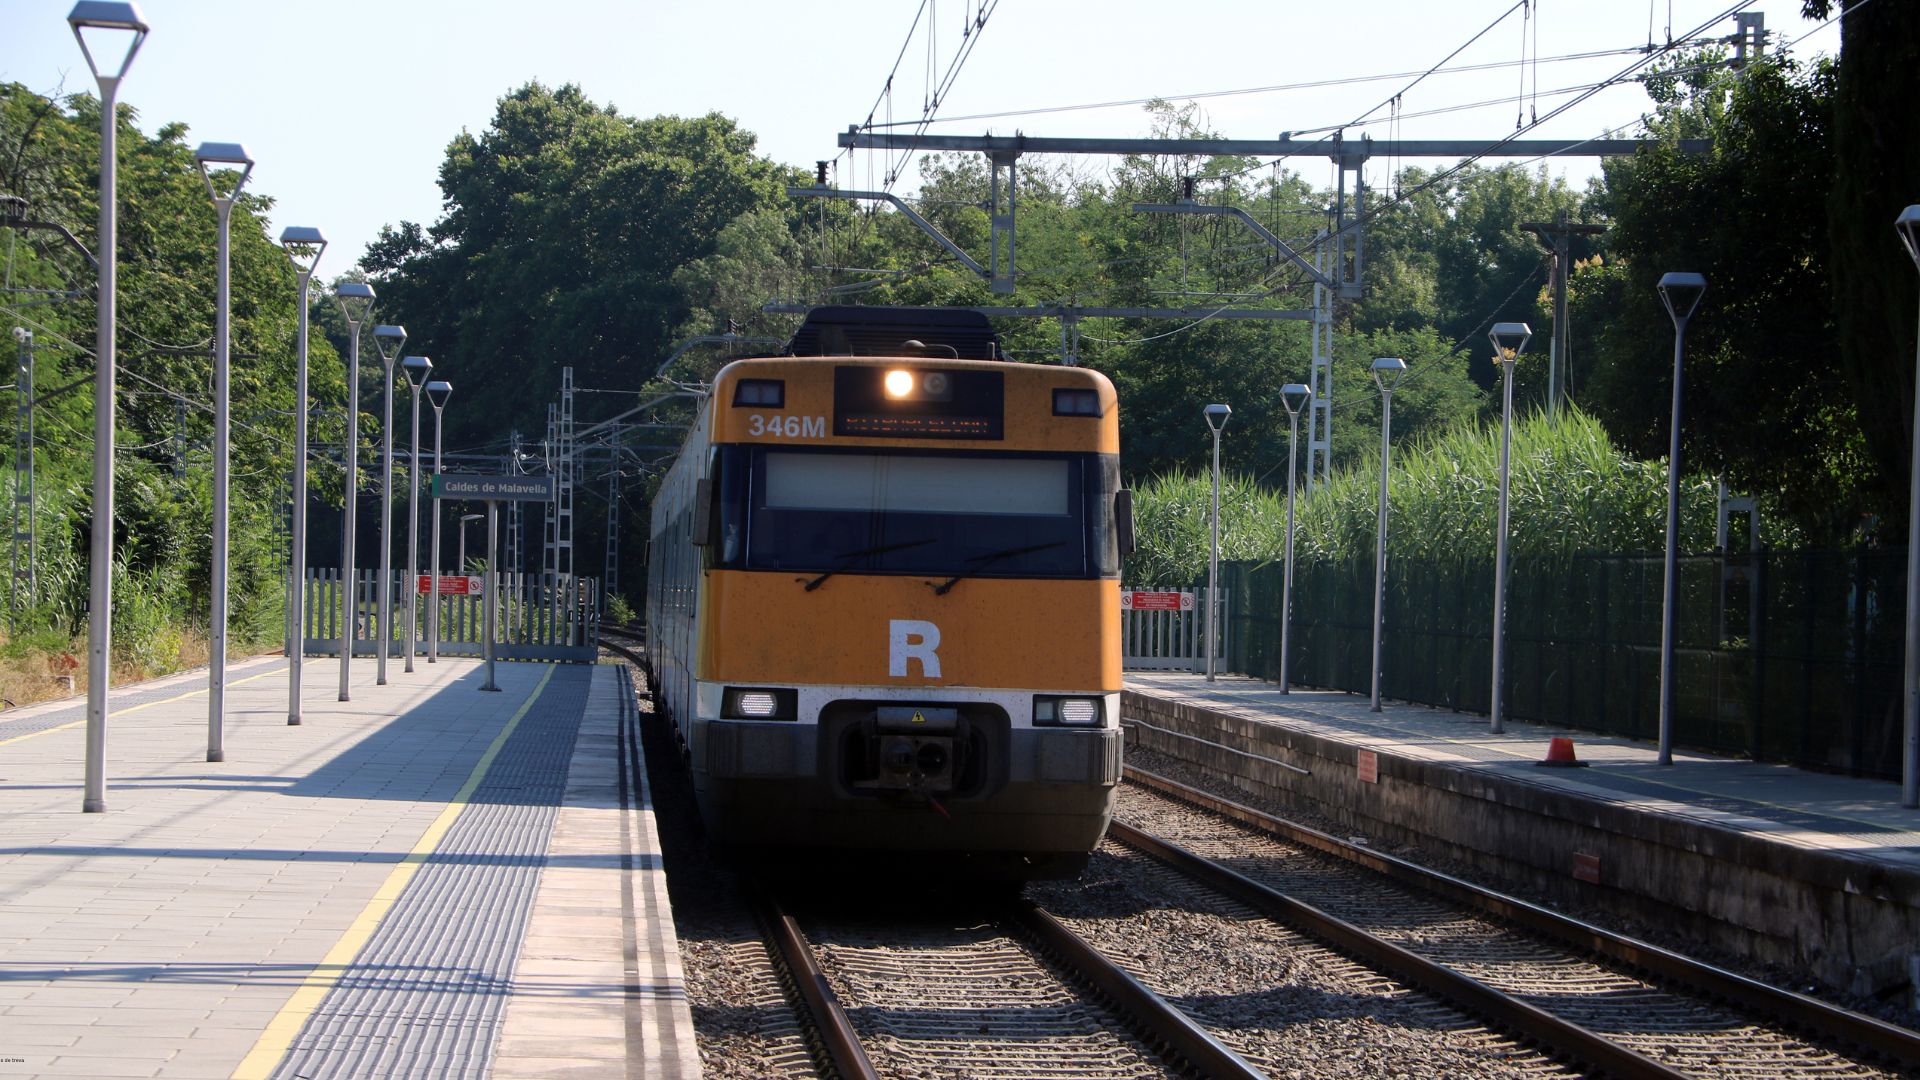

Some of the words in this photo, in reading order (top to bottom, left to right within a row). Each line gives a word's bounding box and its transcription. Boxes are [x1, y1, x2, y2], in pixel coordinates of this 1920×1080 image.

[748, 414, 826, 439] 346M
[445, 481, 479, 492] Caldes
[482, 482, 495, 493] de
[499, 483, 547, 494] Malavella
[888, 619, 942, 678] R
